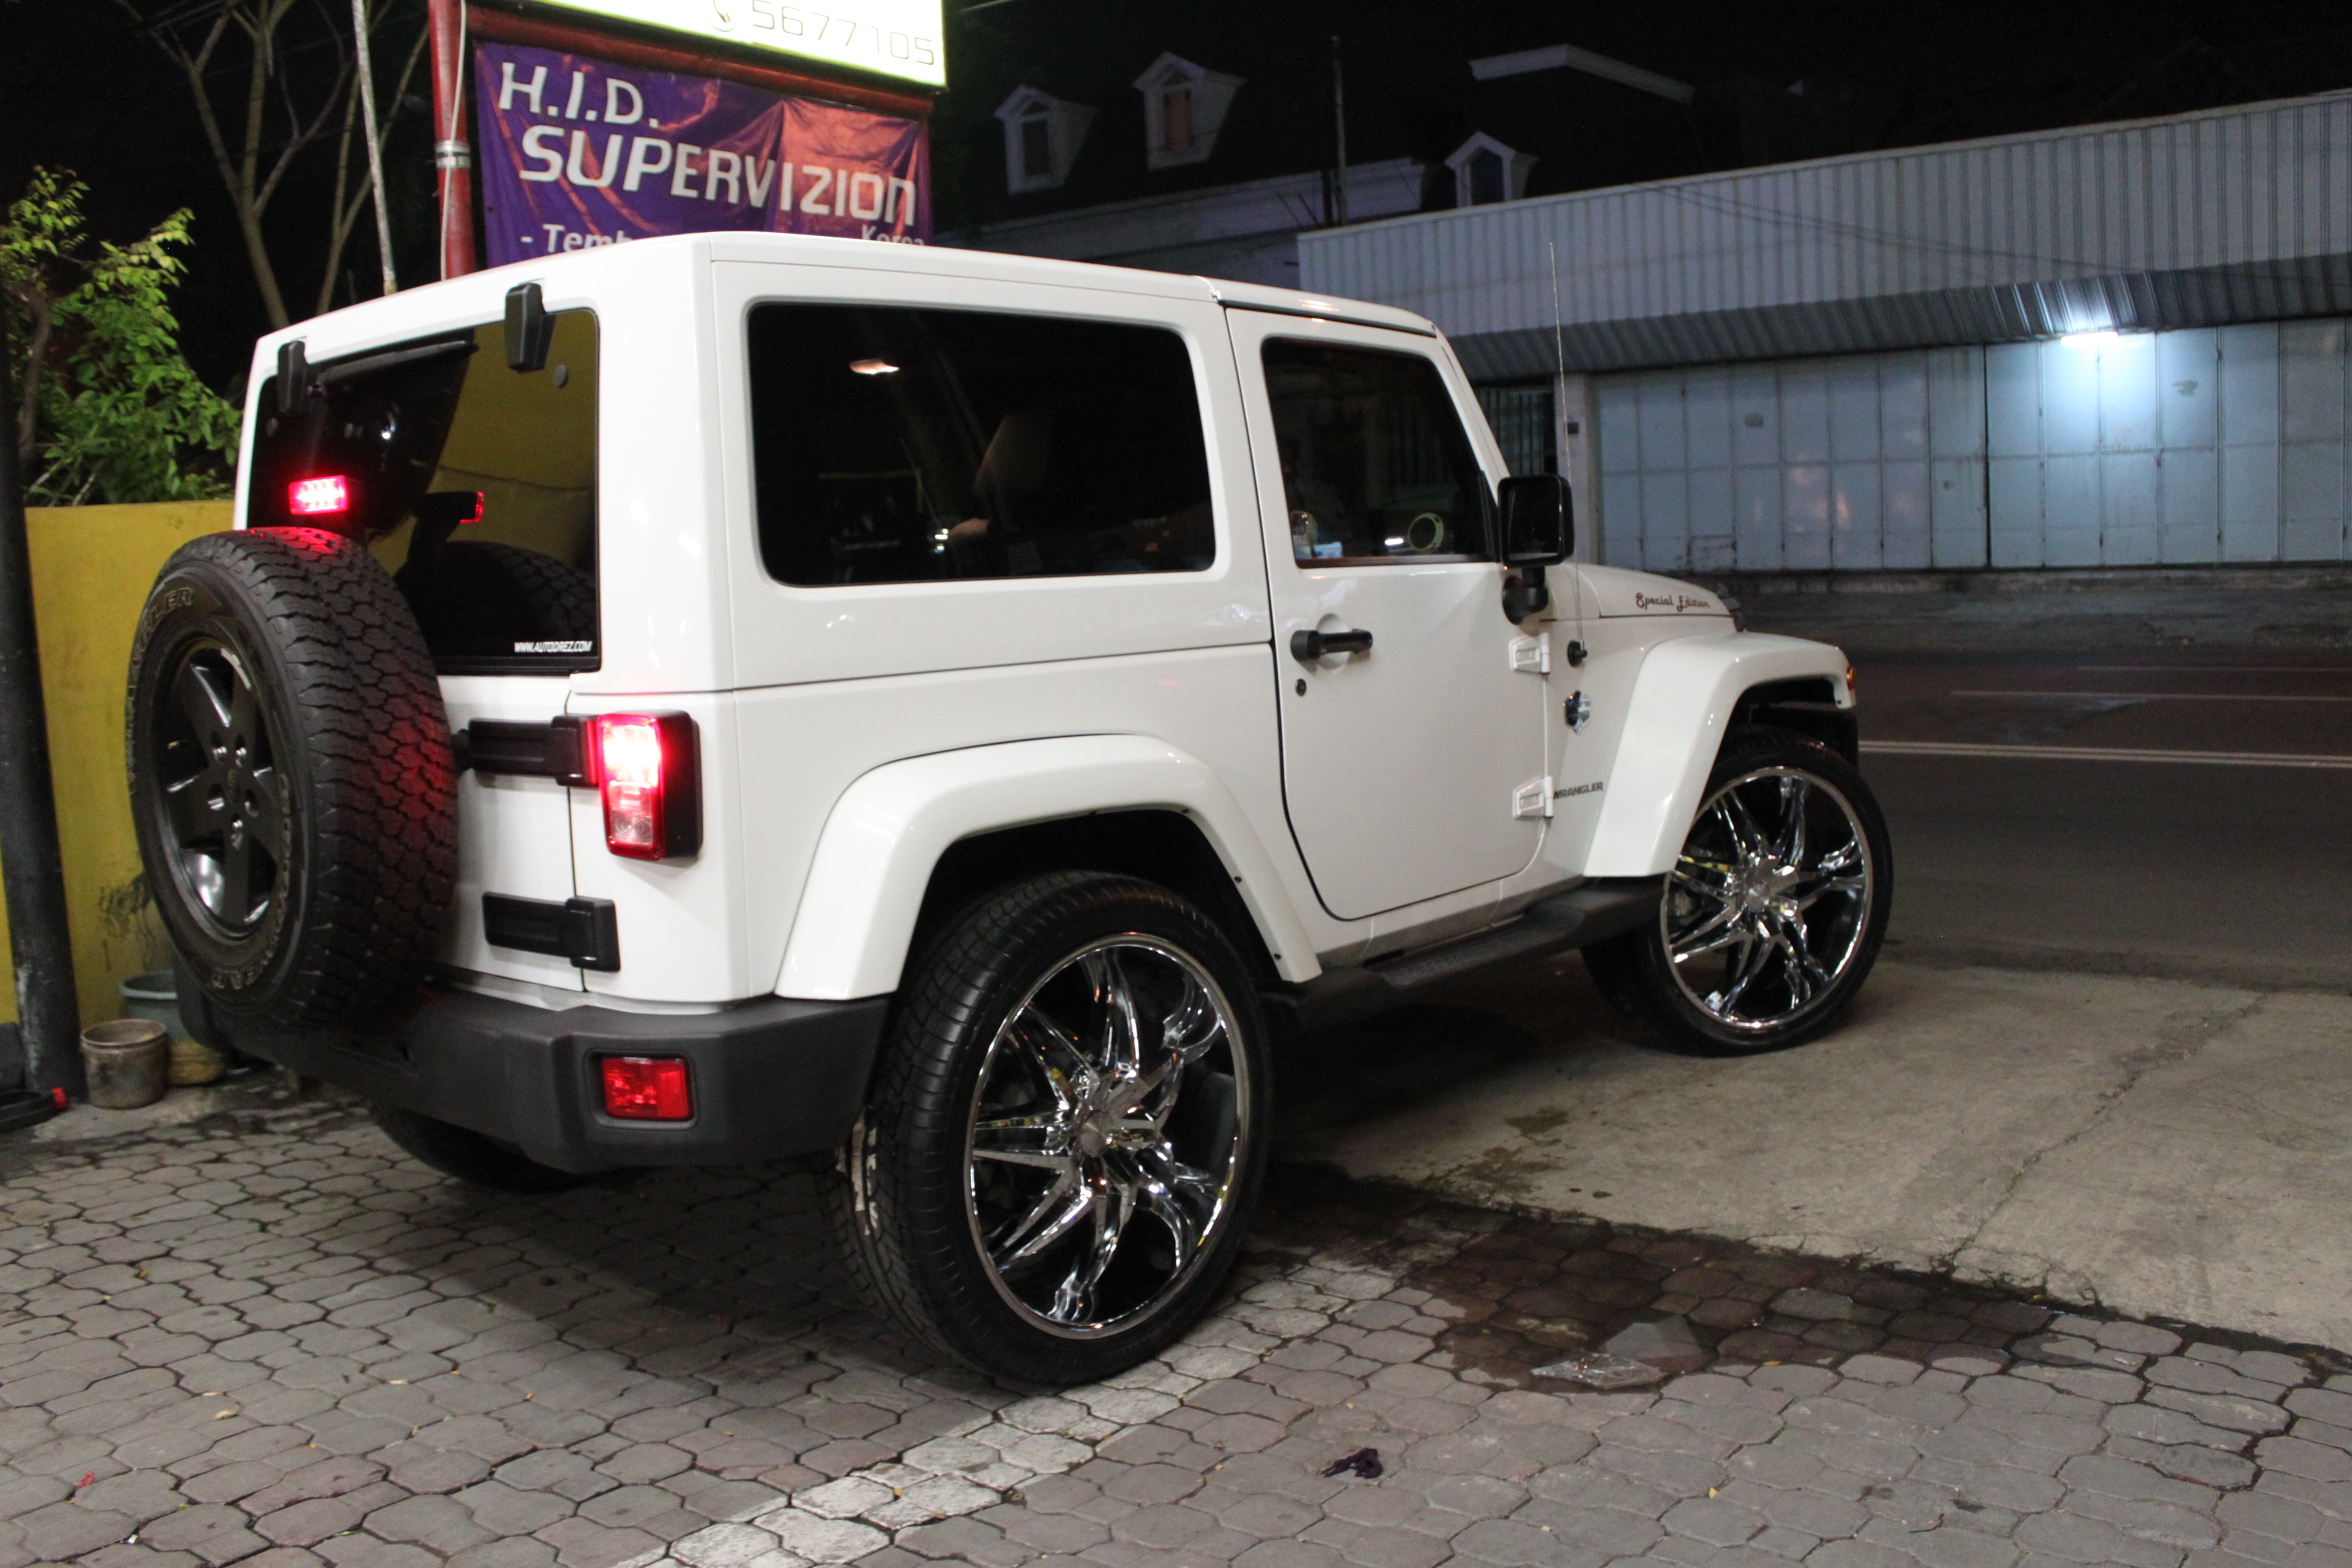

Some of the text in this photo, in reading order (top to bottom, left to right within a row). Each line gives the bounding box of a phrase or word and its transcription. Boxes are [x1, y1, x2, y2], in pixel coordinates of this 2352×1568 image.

[751, 0, 935, 66] 5677105
[499, 61, 659, 129] H.I.D.
[1553, 781, 1604, 800] WRANGLER
